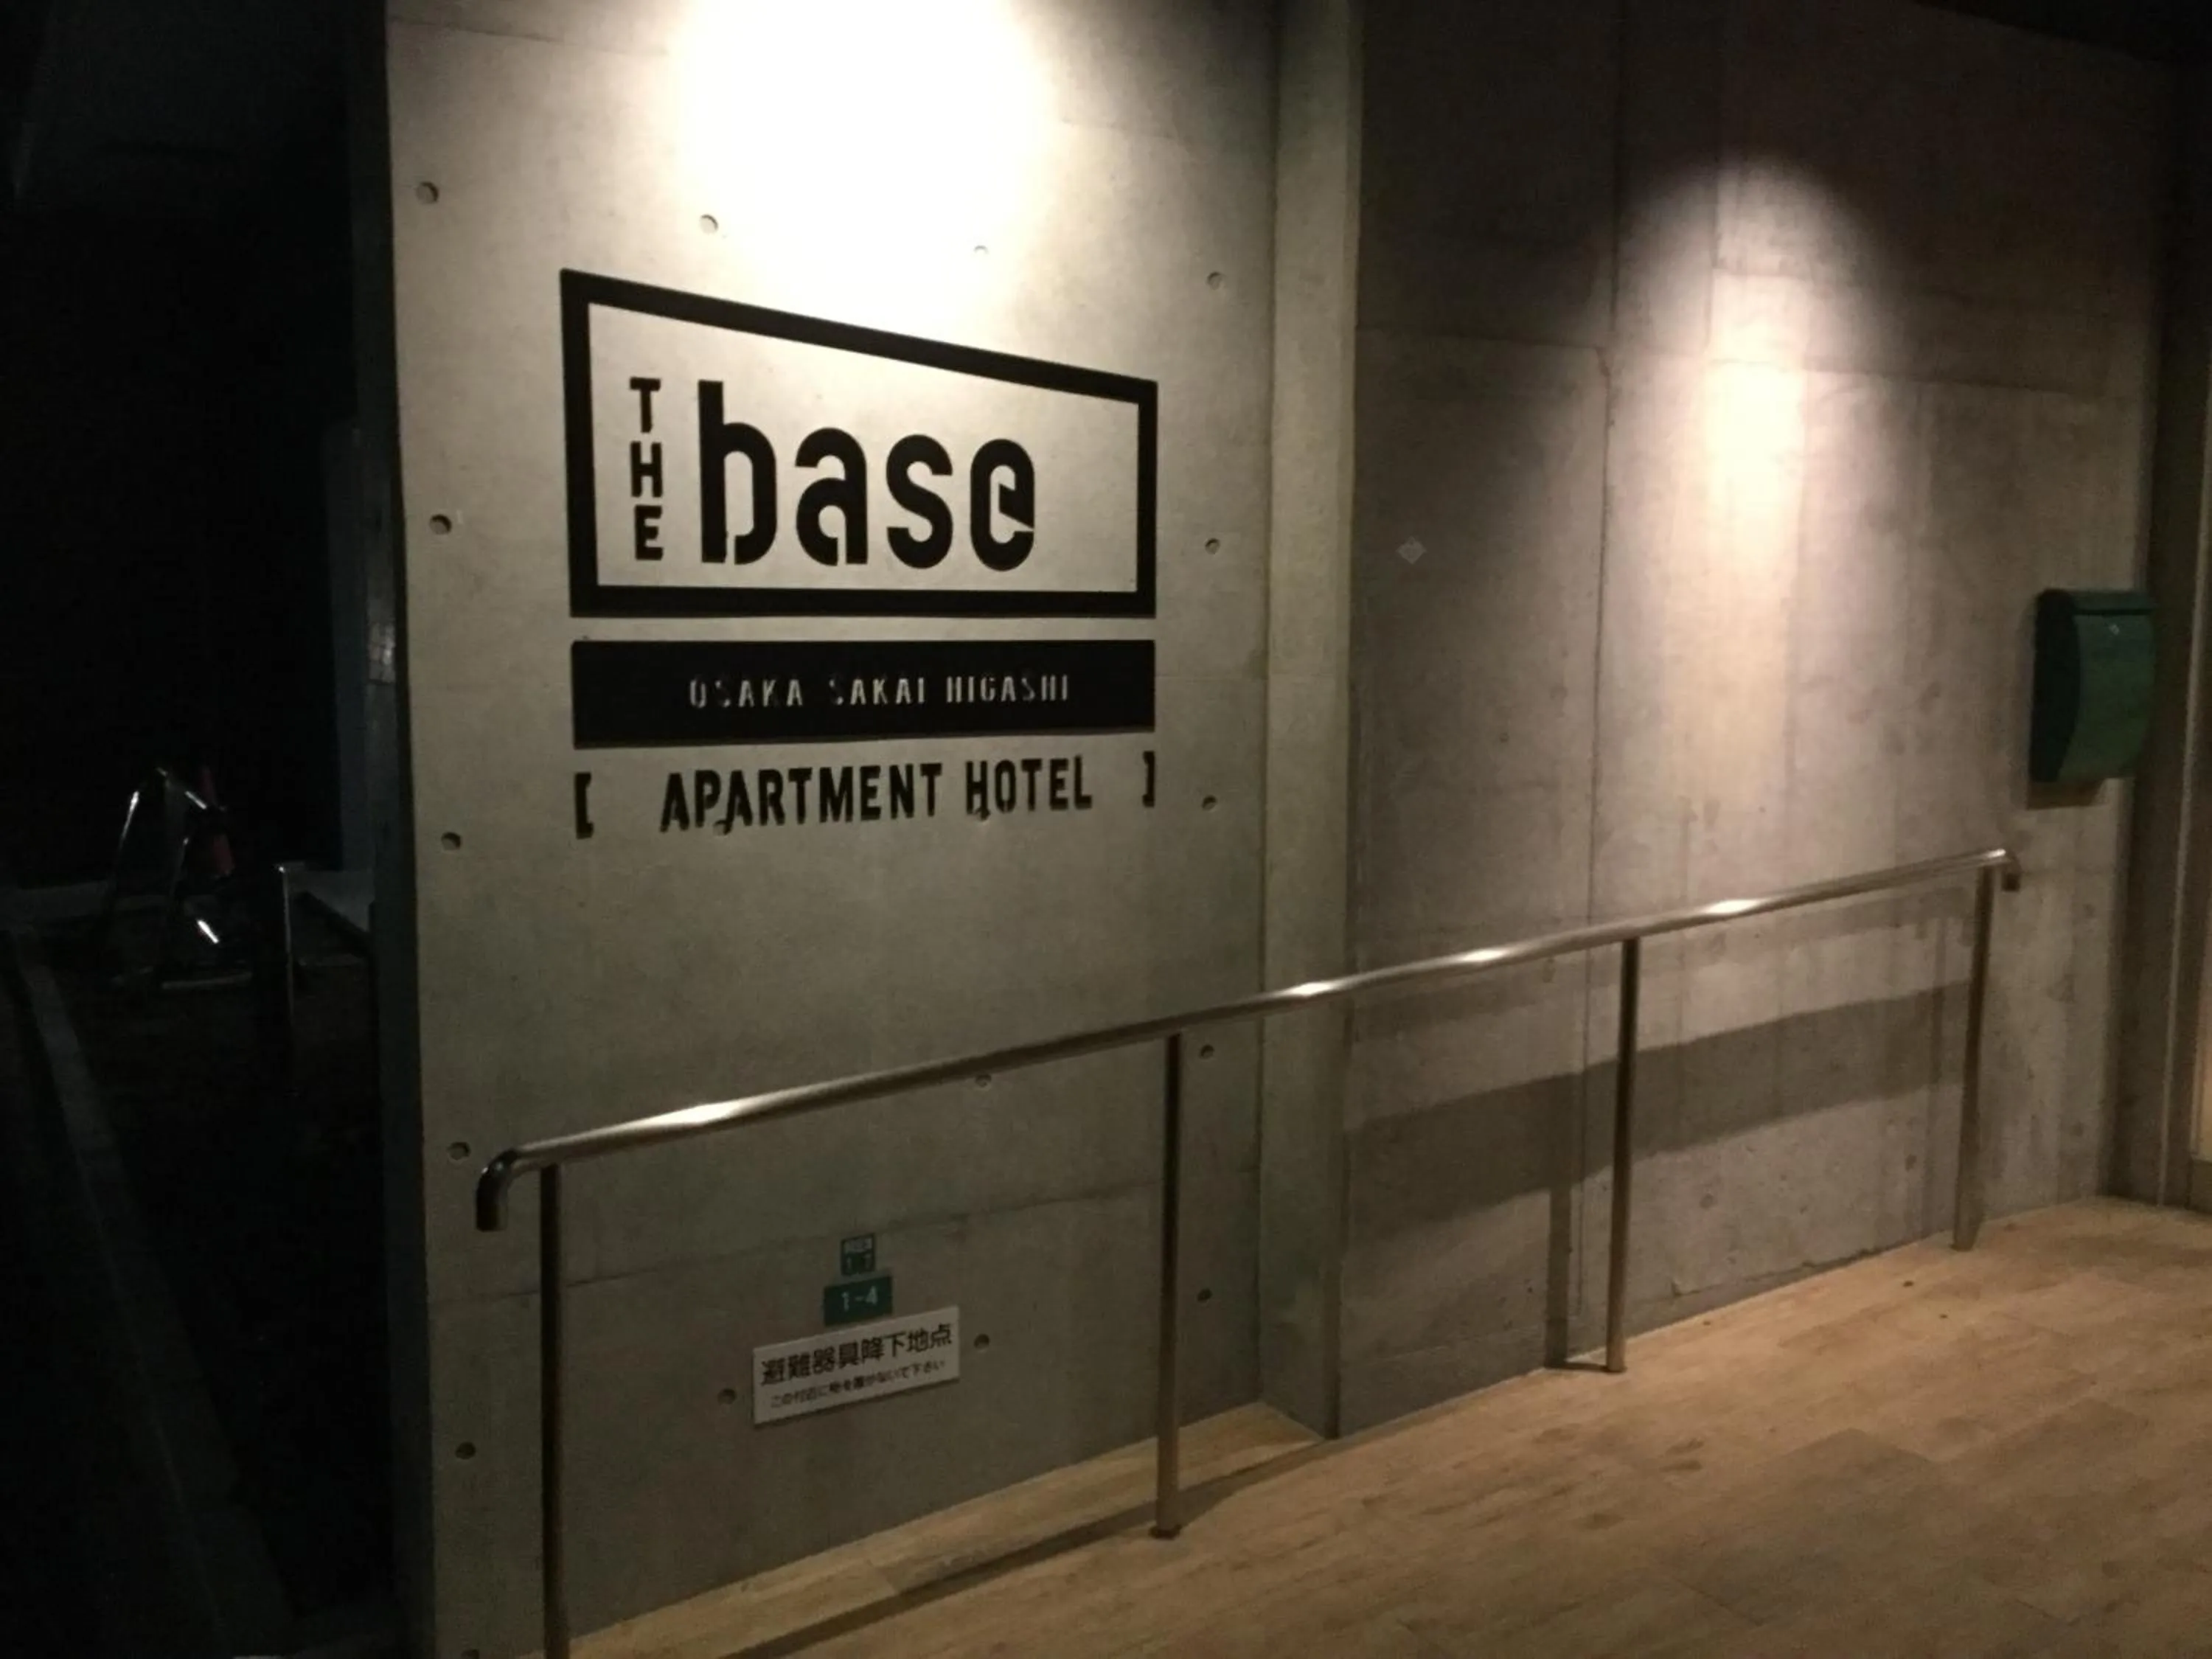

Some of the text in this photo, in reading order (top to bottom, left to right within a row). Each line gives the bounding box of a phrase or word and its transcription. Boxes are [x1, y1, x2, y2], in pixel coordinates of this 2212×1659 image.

[629, 377, 664, 560] THE
[698, 379, 1036, 571] base
[688, 673, 1069, 709] OSAKA SAKAI HIGASHI
[659, 762, 942, 833] APARTMENT
[965, 754, 1093, 818] HOTEL
